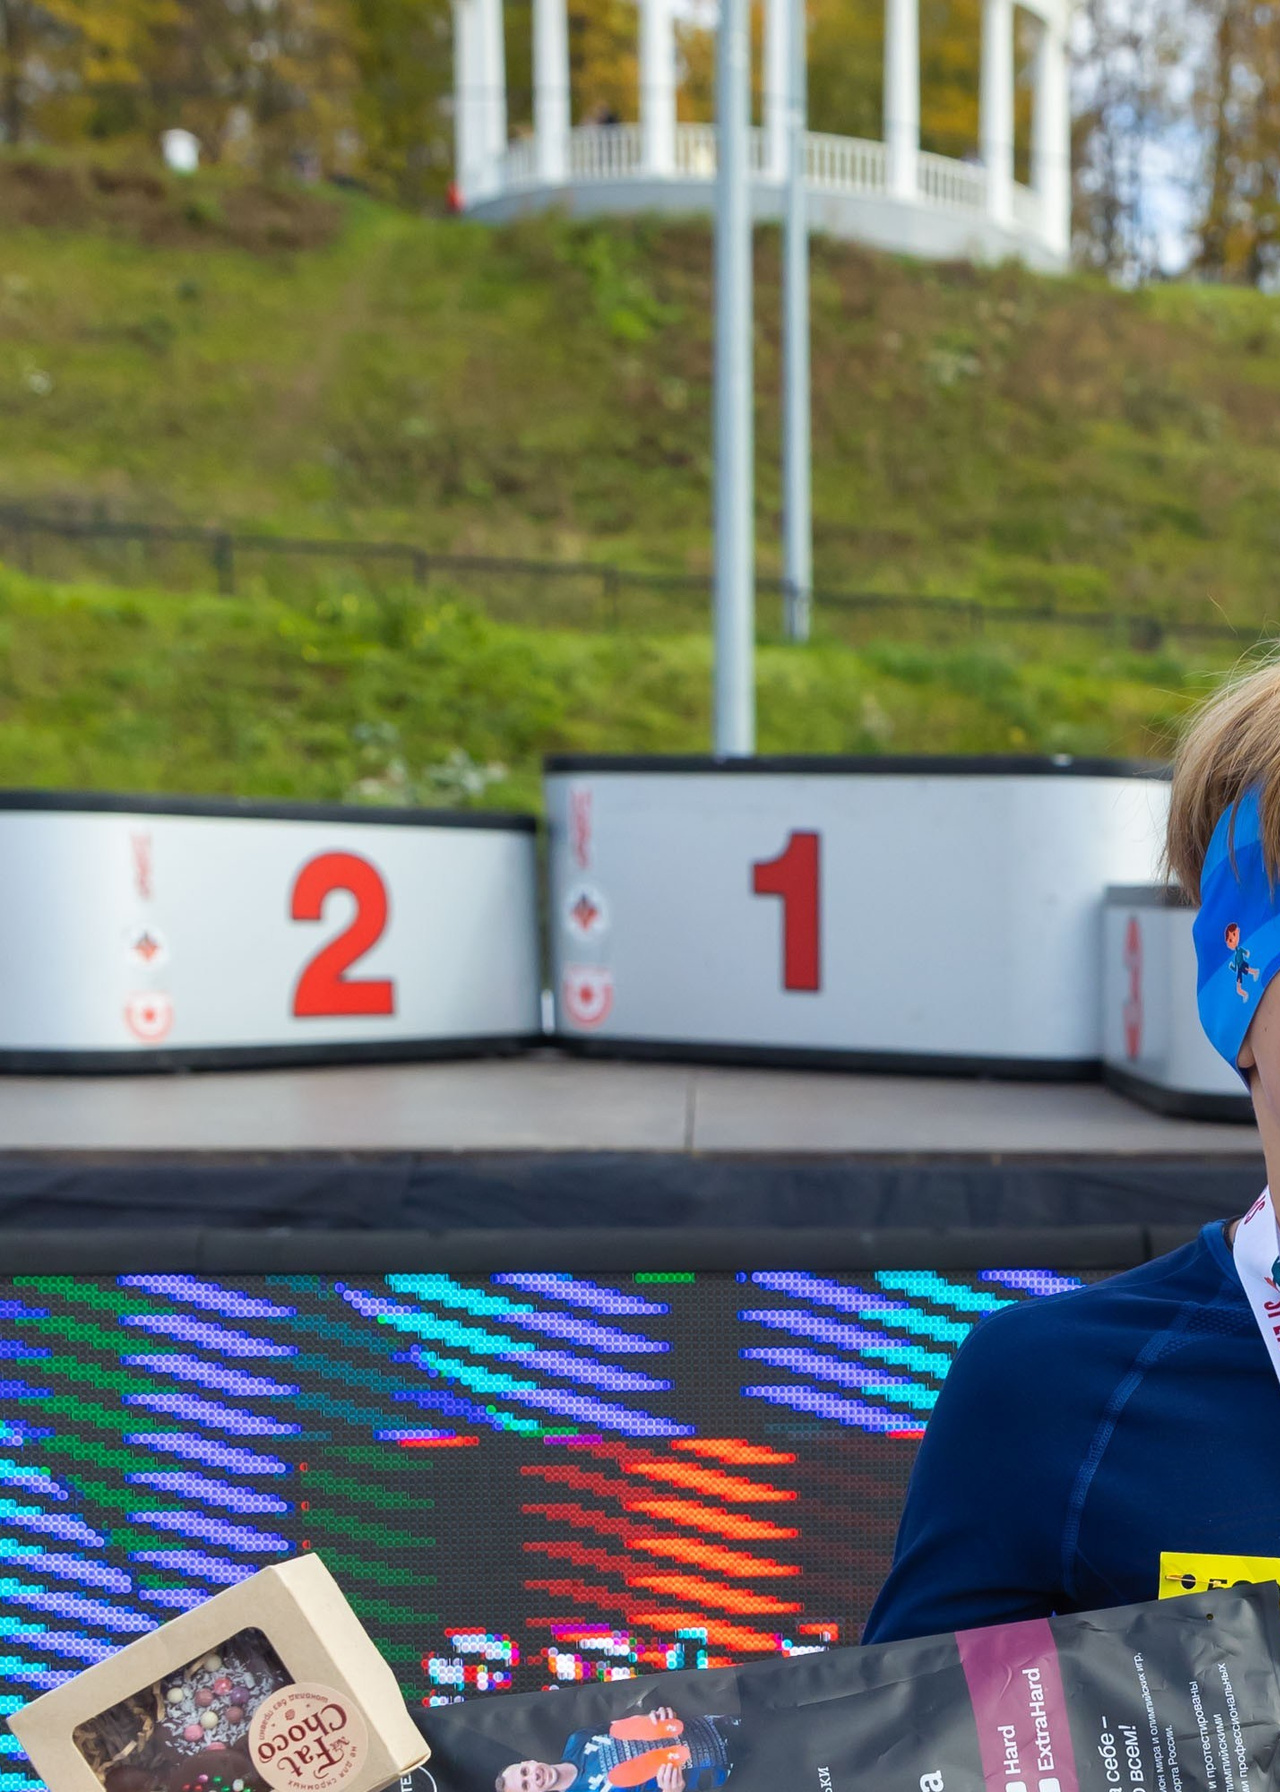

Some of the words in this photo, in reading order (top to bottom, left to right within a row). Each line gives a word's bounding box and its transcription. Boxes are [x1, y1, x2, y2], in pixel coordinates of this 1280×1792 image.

[289, 851, 395, 1017] 2
[751, 829, 822, 992] 1
[258, 1703, 348, 1764] Choco
[1022, 1667, 1054, 1771] ExtraHard
[1138, 1673, 1159, 1735] олимпийских
[1189, 1681, 1217, 1778] протестированы
[1218, 1663, 1248, 1778] профессиональных
[276, 1735, 345, 1780] Fat
[997, 1724, 1021, 1774] Hard
[1098, 1732, 1121, 1782] себе
[1118, 1724, 1144, 1782] всем!
[1153, 1745, 1164, 1773] мира
[1209, 1780, 1218, 1789] и
